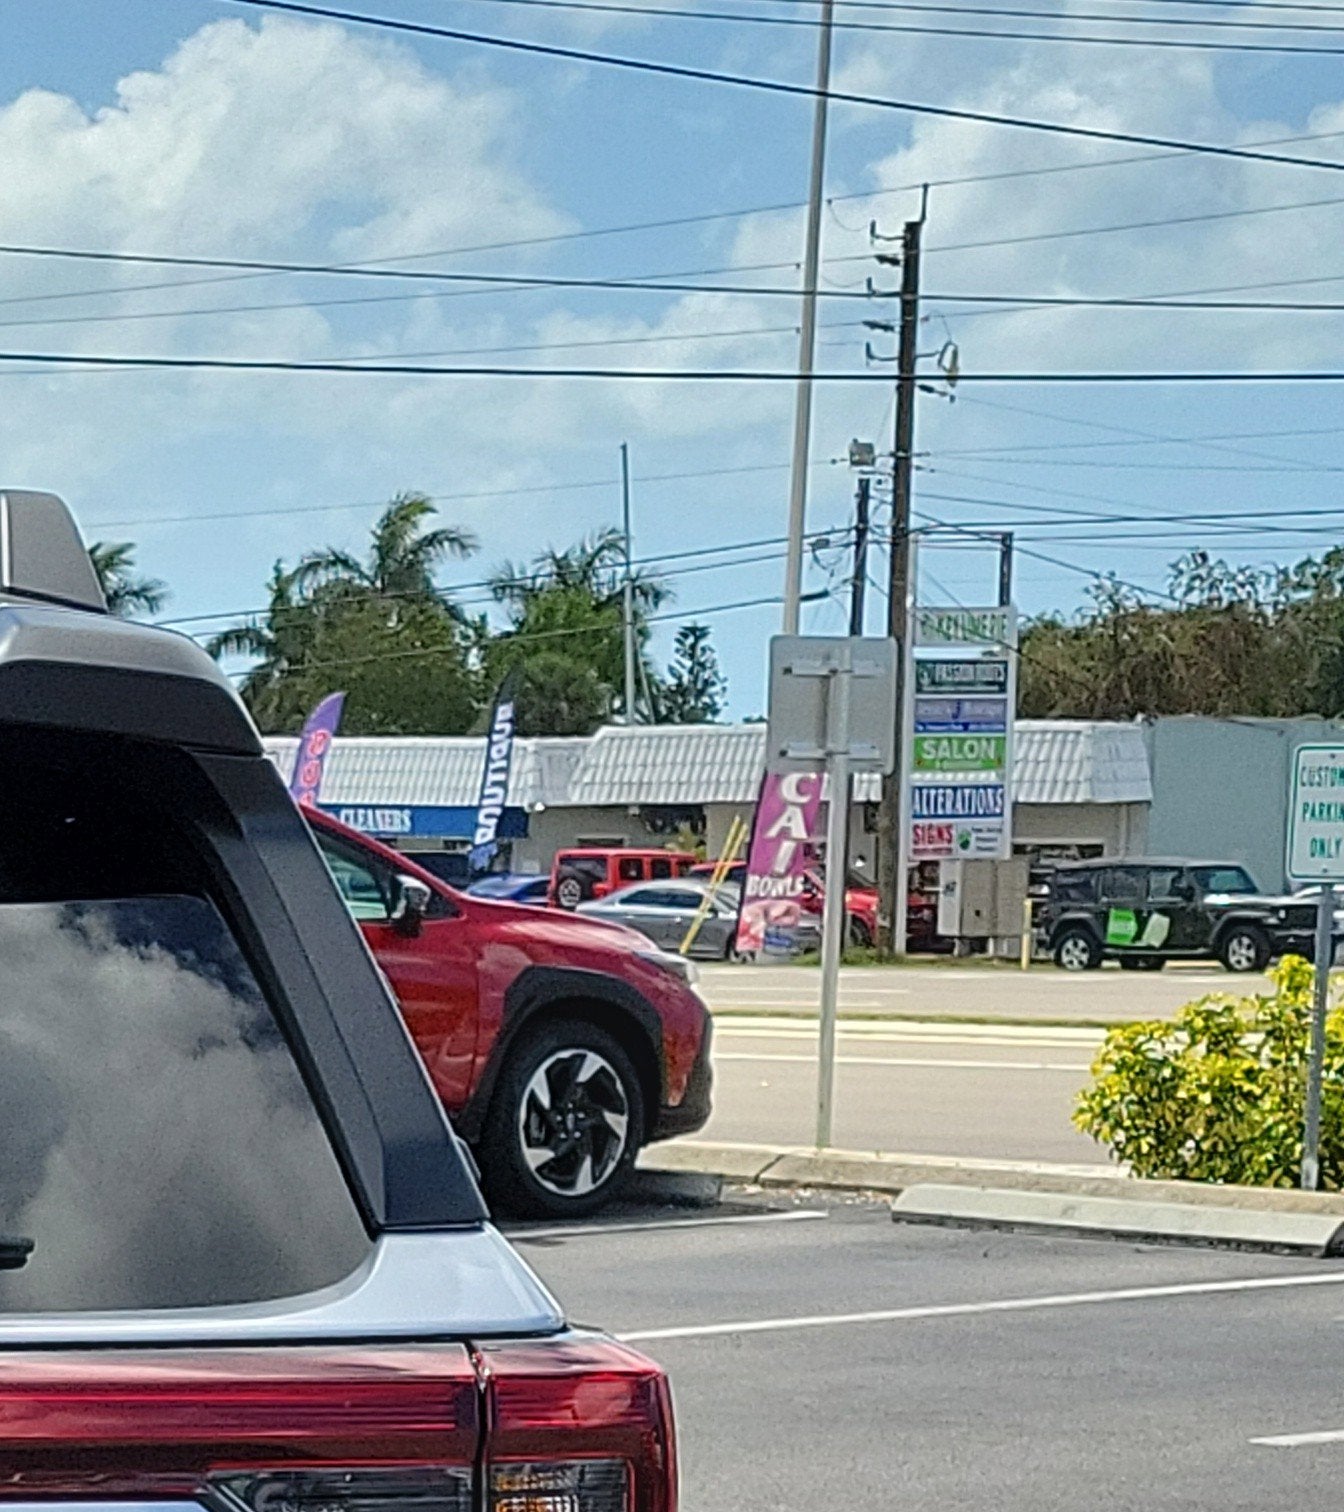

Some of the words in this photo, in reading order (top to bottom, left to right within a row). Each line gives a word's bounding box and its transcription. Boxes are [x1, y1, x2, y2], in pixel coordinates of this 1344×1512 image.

[921, 738, 996, 760] SALON
[913, 787, 1005, 815] ALTERATIONS
[913, 823, 953, 845] SIGNS
[1310, 838, 1342, 858] ONLY
[746, 873, 805, 897] BOWLS
